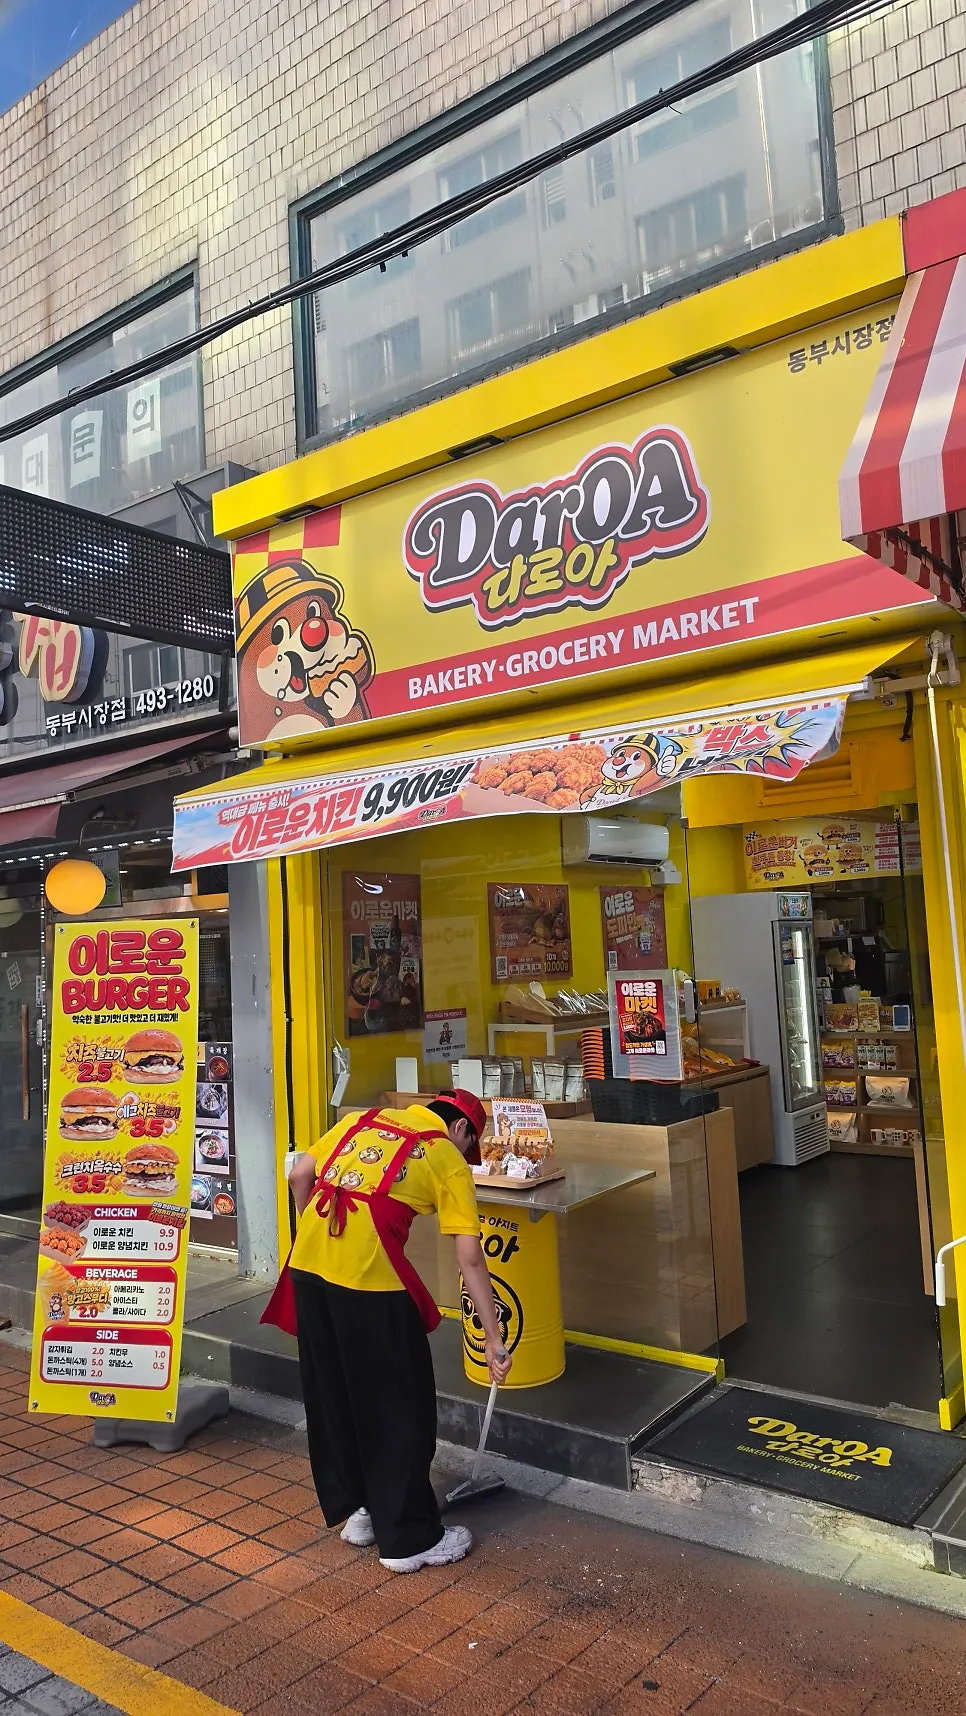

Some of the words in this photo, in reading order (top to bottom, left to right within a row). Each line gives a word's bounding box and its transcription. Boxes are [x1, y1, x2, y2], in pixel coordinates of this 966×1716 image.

[788, 314, 895, 374] 동부시장점
[411, 439, 698, 586] DarOA
[482, 538, 618, 610] 다로아
[633, 596, 760, 650] MARKET
[46, 697, 126, 737] 동부시장점
[136, 674, 214, 714] 493-1280
[248, 801, 267, 814] 메뉴
[268, 793, 290, 811] 출시!
[231, 785, 365, 854] 이로운치킨
[745, 835, 798, 856] 이로운버거
[351, 900, 418, 920] 이로운마켓
[604, 890, 634, 917] 이로운
[68, 928, 187, 976] 이로운
[61, 976, 190, 1014] BURGER
[621, 981, 657, 997] 이로운
[624, 996, 658, 1013] 마켓
[94, 1014, 121, 1024] 불고기맛!
[122, 1014, 129, 1023] 더
[150, 1014, 156, 1022] 더
[66, 1043, 125, 1062] 치즈불고기
[77, 1061, 112, 1082] 2.5
[130, 1117, 164, 1137] 3.5
[61, 1159, 122, 1178] 크런치옥수수
[72, 1173, 106, 1193] 3.5
[94, 1208, 137, 1217] CHICKEN
[93, 1227, 116, 1237] 이로운
[117, 1227, 134, 1237] 치킨
[160, 1228, 174, 1237] 9.9
[488, 1216, 519, 1232] 아지트
[92, 1241, 116, 1250] 이로운
[117, 1241, 148, 1251] 양념치킨
[154, 1242, 174, 1251] 10.9
[85, 1268, 138, 1278] BEVERAGE
[113, 1285, 145, 1293] 아메리카노
[113, 1296, 138, 1305] 아이스티
[78, 1306, 98, 1318] 2.0
[156, 1309, 169, 1317] 2.0
[96, 1330, 119, 1340] SIDE
[92, 1347, 104, 1355] 2.0
[153, 1362, 165, 1370] 0.5
[747, 1416, 893, 1467] DarOA
[765, 1440, 854, 1468] 다로아
[820, 1466, 862, 1482] MARKET
